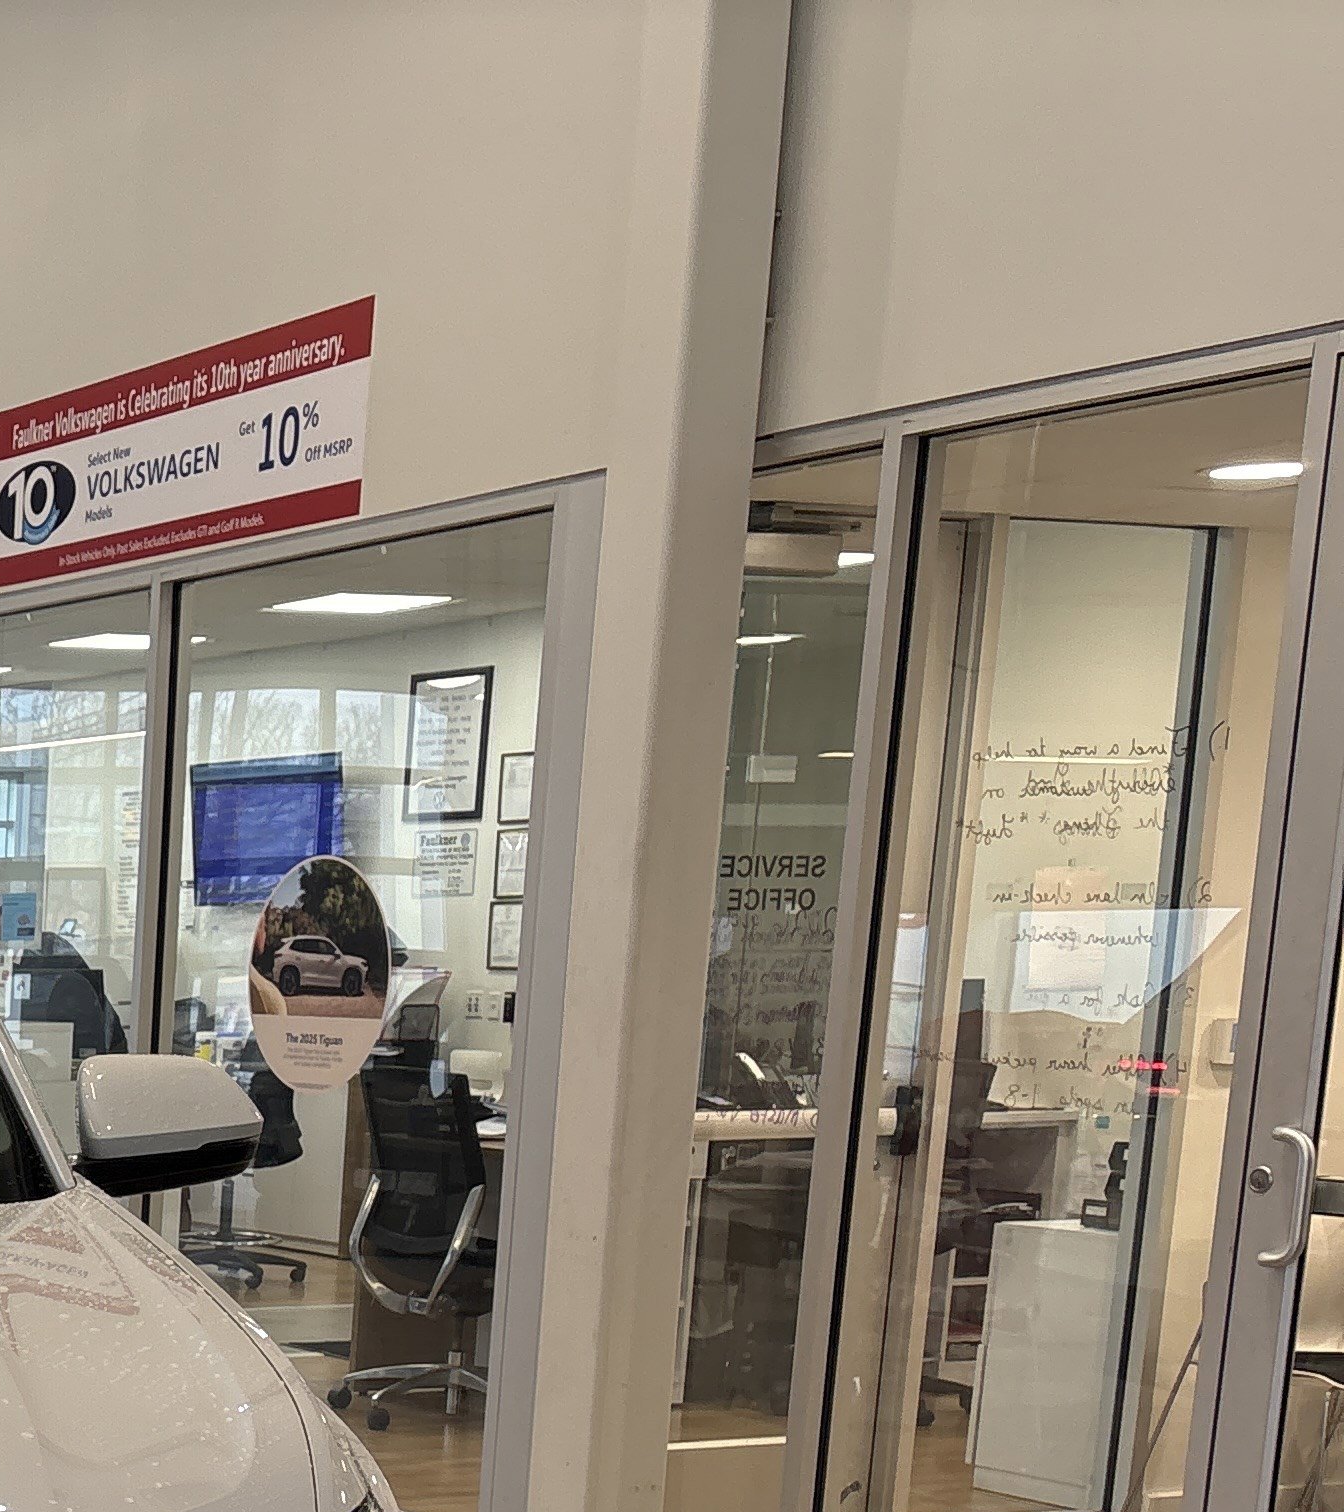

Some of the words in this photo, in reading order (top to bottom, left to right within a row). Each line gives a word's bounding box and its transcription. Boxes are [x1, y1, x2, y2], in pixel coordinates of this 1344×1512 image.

[12, 418, 54, 450] Faulkner
[55, 403, 115, 438] Volkswagen
[116, 392, 126, 420] is
[127, 375, 190, 417] Celebrating
[209, 358, 237, 394] 10th
[239, 356, 266, 393] year
[267, 333, 345, 376] anniversary.
[239, 420, 255, 436] Get
[87, 450, 112, 468] Select
[113, 446, 132, 461] New
[304, 444, 322, 462] Off
[323, 438, 353, 458] MSRP
[87, 442, 220, 500] VOLKSWAGEN
[7, 465, 55, 540] 10
[85, 505, 113, 523] Models
[286, 1032, 298, 1043] The
[319, 1034, 343, 1047] Tiguan
